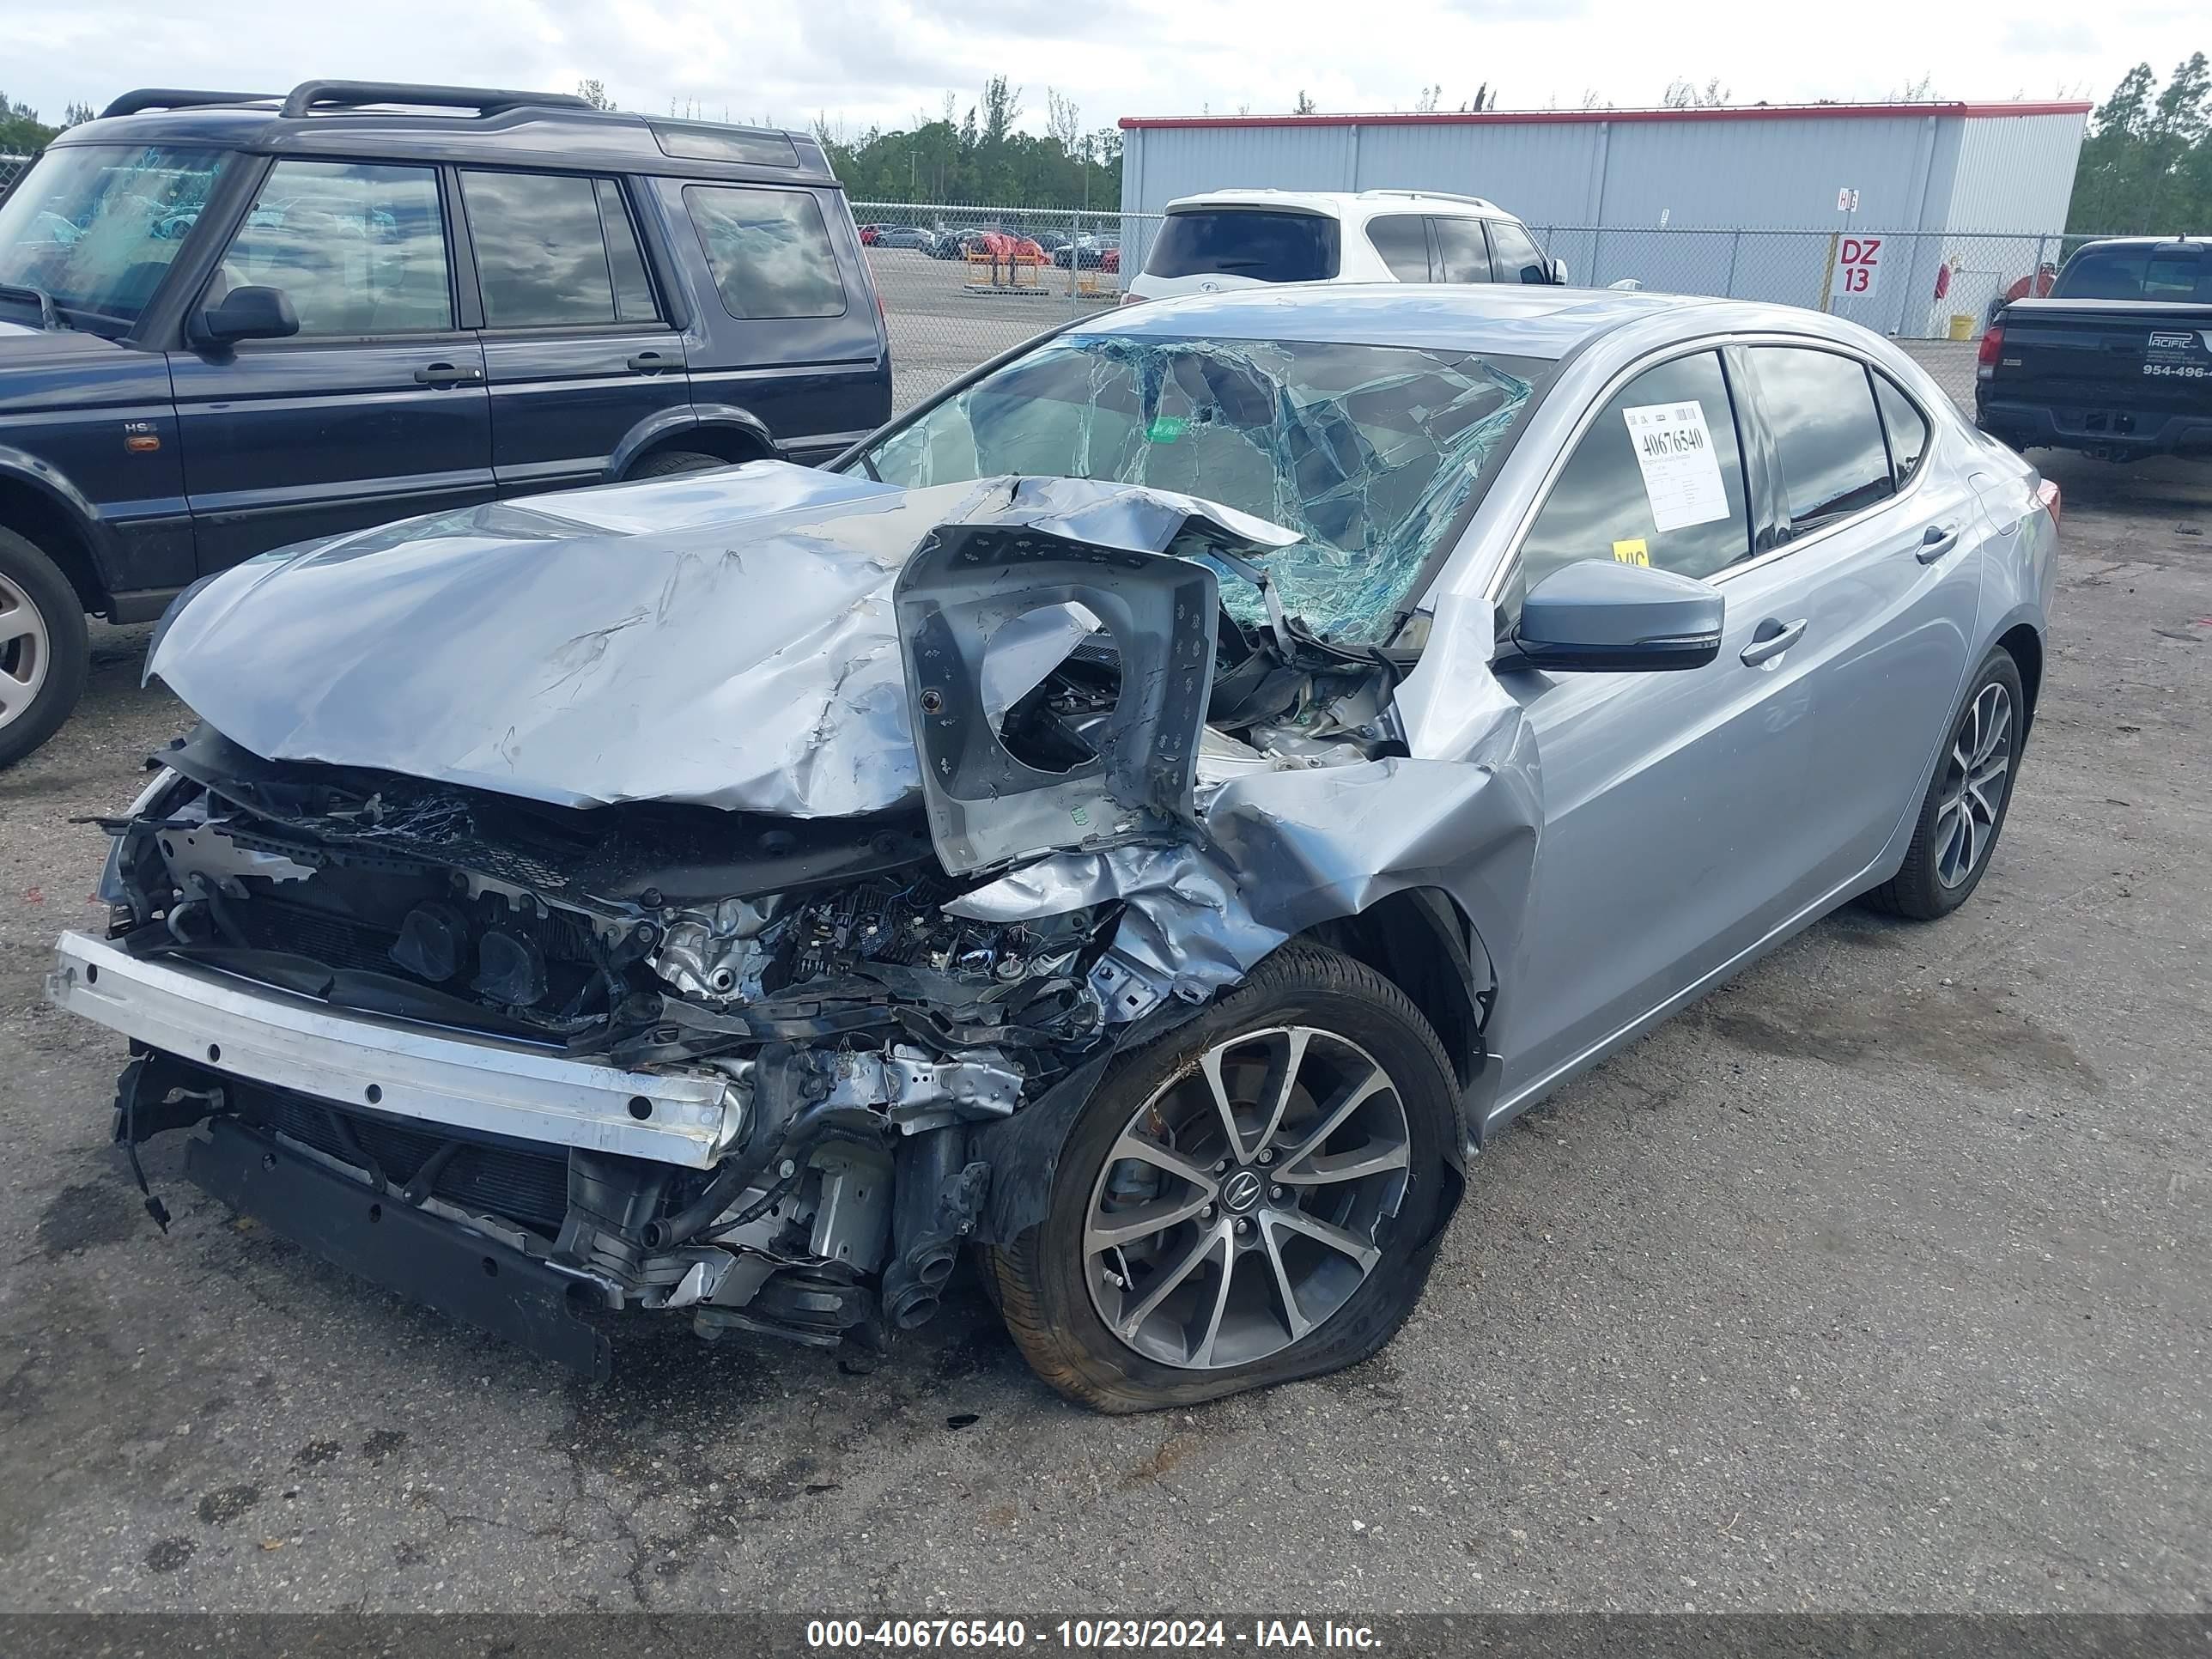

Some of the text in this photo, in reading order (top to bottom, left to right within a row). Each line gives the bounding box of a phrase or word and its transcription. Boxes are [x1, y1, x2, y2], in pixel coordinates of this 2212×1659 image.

[1841, 240, 1881, 264] DZ
[1844, 268, 1869, 292] 13
[2148, 331, 2193, 349] PACIFIC
[1643, 428, 1704, 456] 40676540
